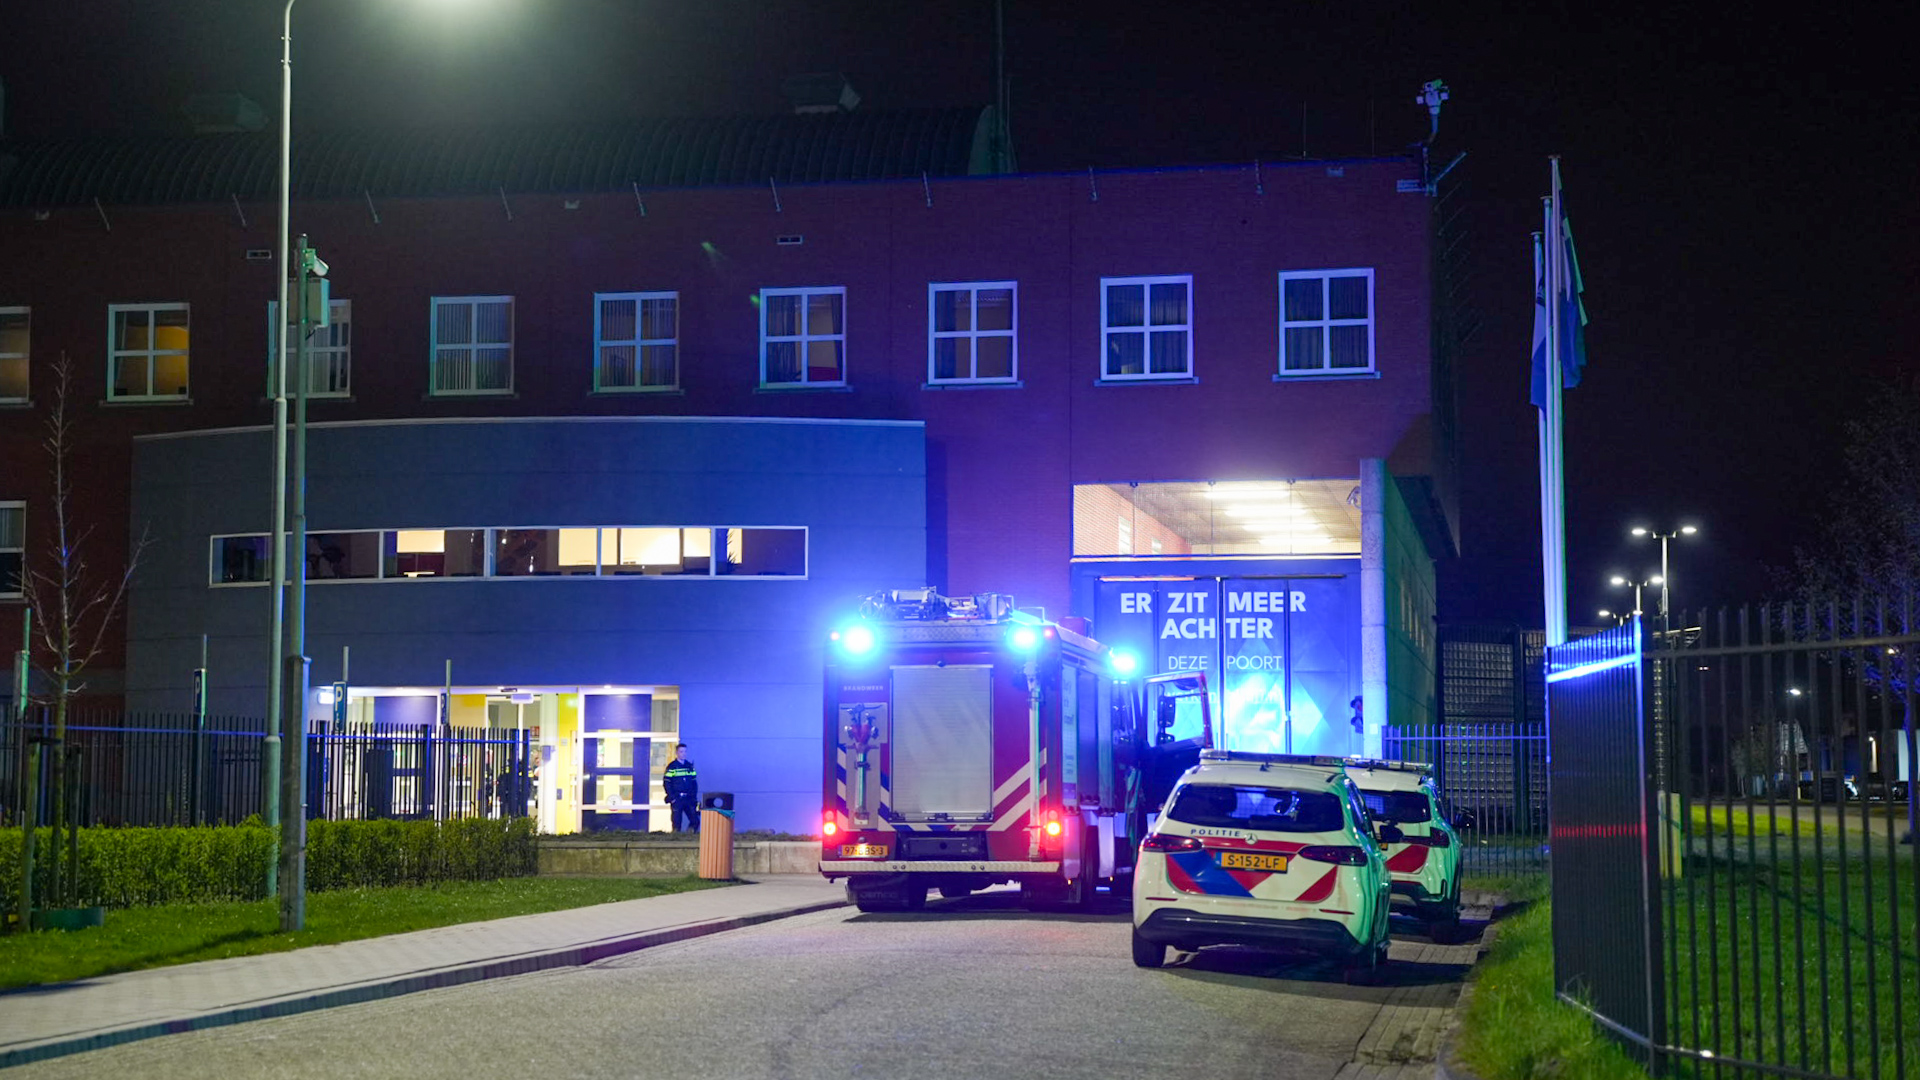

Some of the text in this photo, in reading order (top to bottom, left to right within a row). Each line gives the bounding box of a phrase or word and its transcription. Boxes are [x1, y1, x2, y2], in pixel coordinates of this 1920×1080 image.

[1120, 591, 1307, 614] ER ZIT MEER
[1168, 655, 1282, 670] DEZE POORT
[334, 686, 344, 712] P
[1191, 829, 1241, 837] POLITIE
[1227, 854, 1280, 869] S-152-LF
